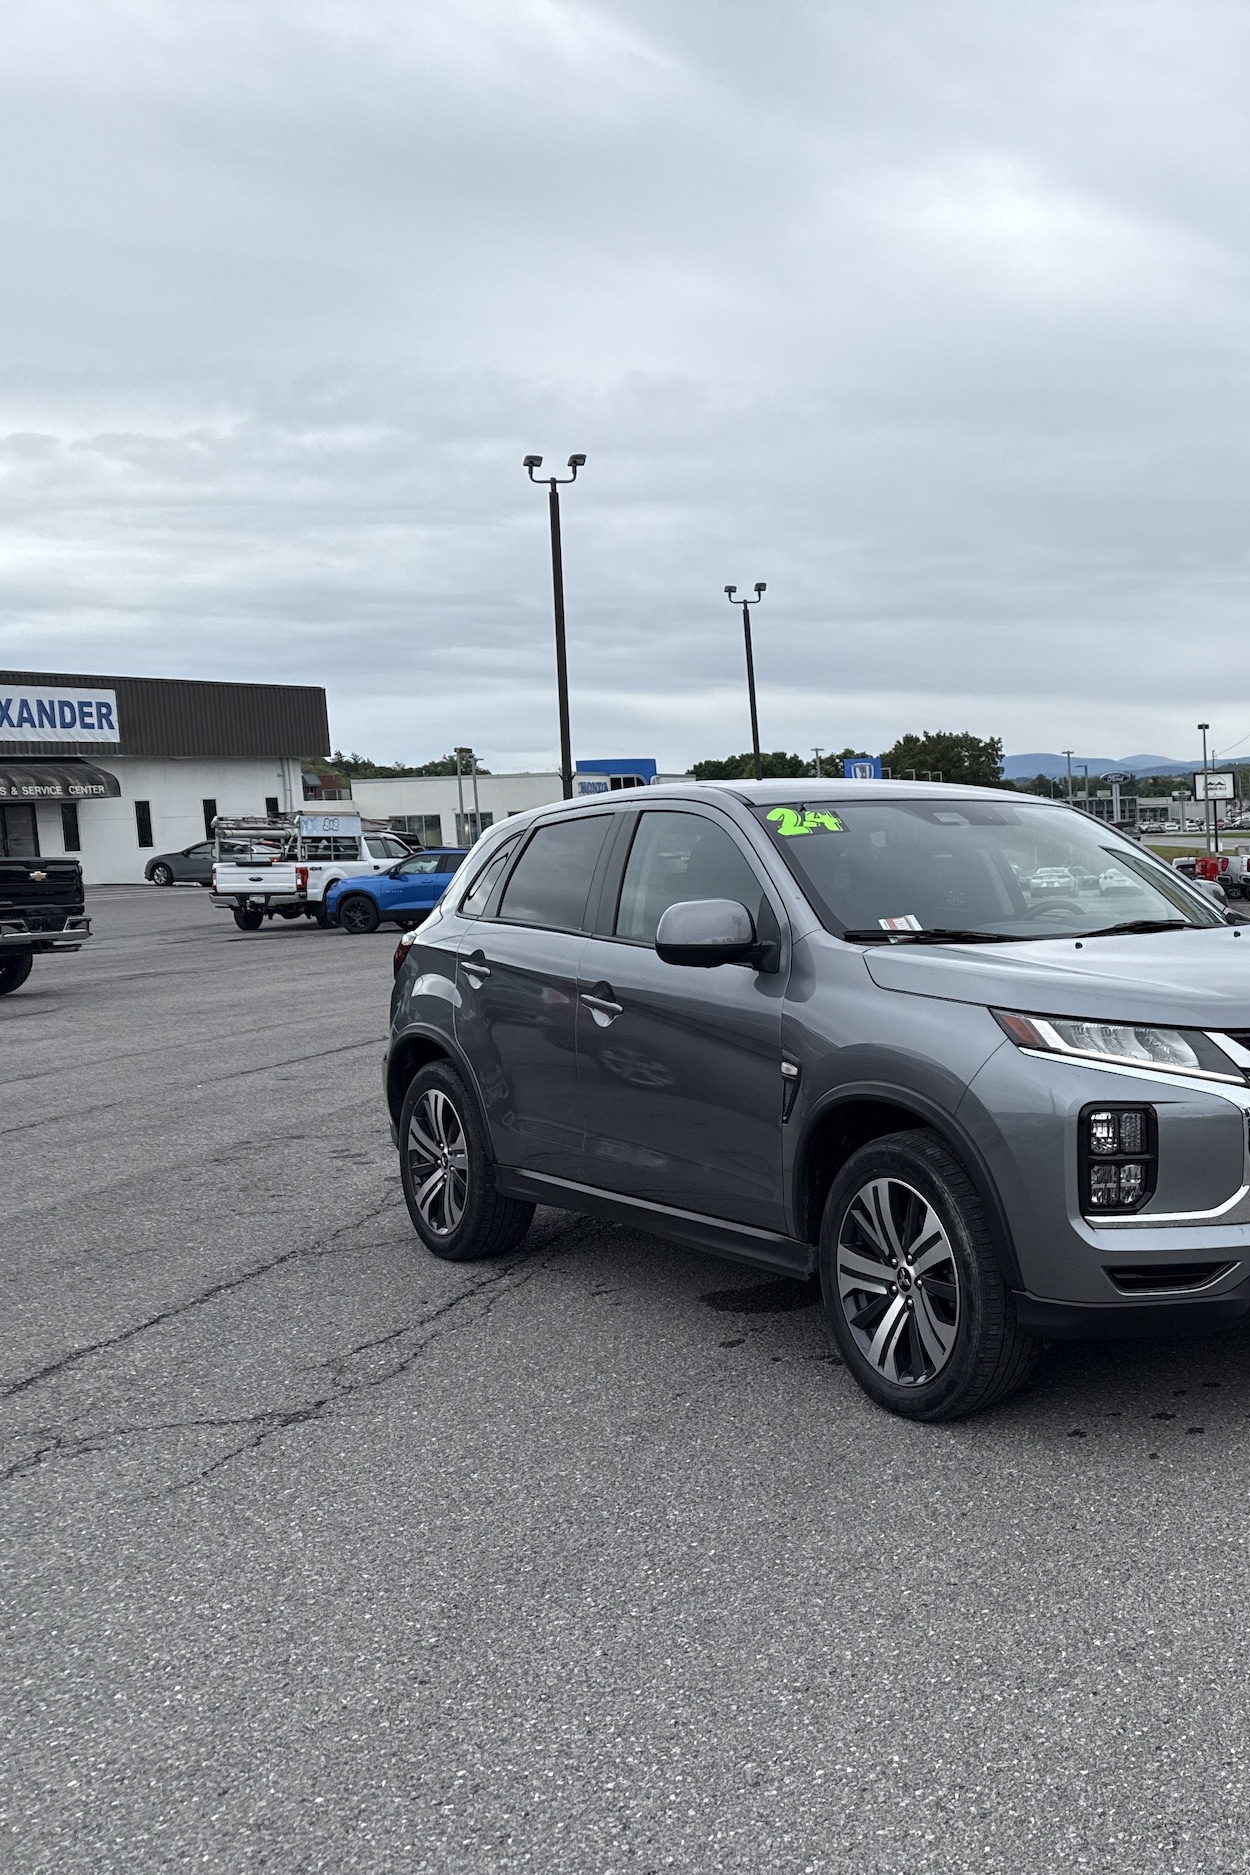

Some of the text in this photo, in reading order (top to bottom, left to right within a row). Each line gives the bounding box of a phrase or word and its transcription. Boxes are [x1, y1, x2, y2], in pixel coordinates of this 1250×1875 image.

[11, 786, 18, 796] &
[22, 785, 63, 795] SERVICE
[68, 784, 105, 795] CENTER
[578, 781, 609, 794] HONDA
[766, 807, 844, 836] 24
